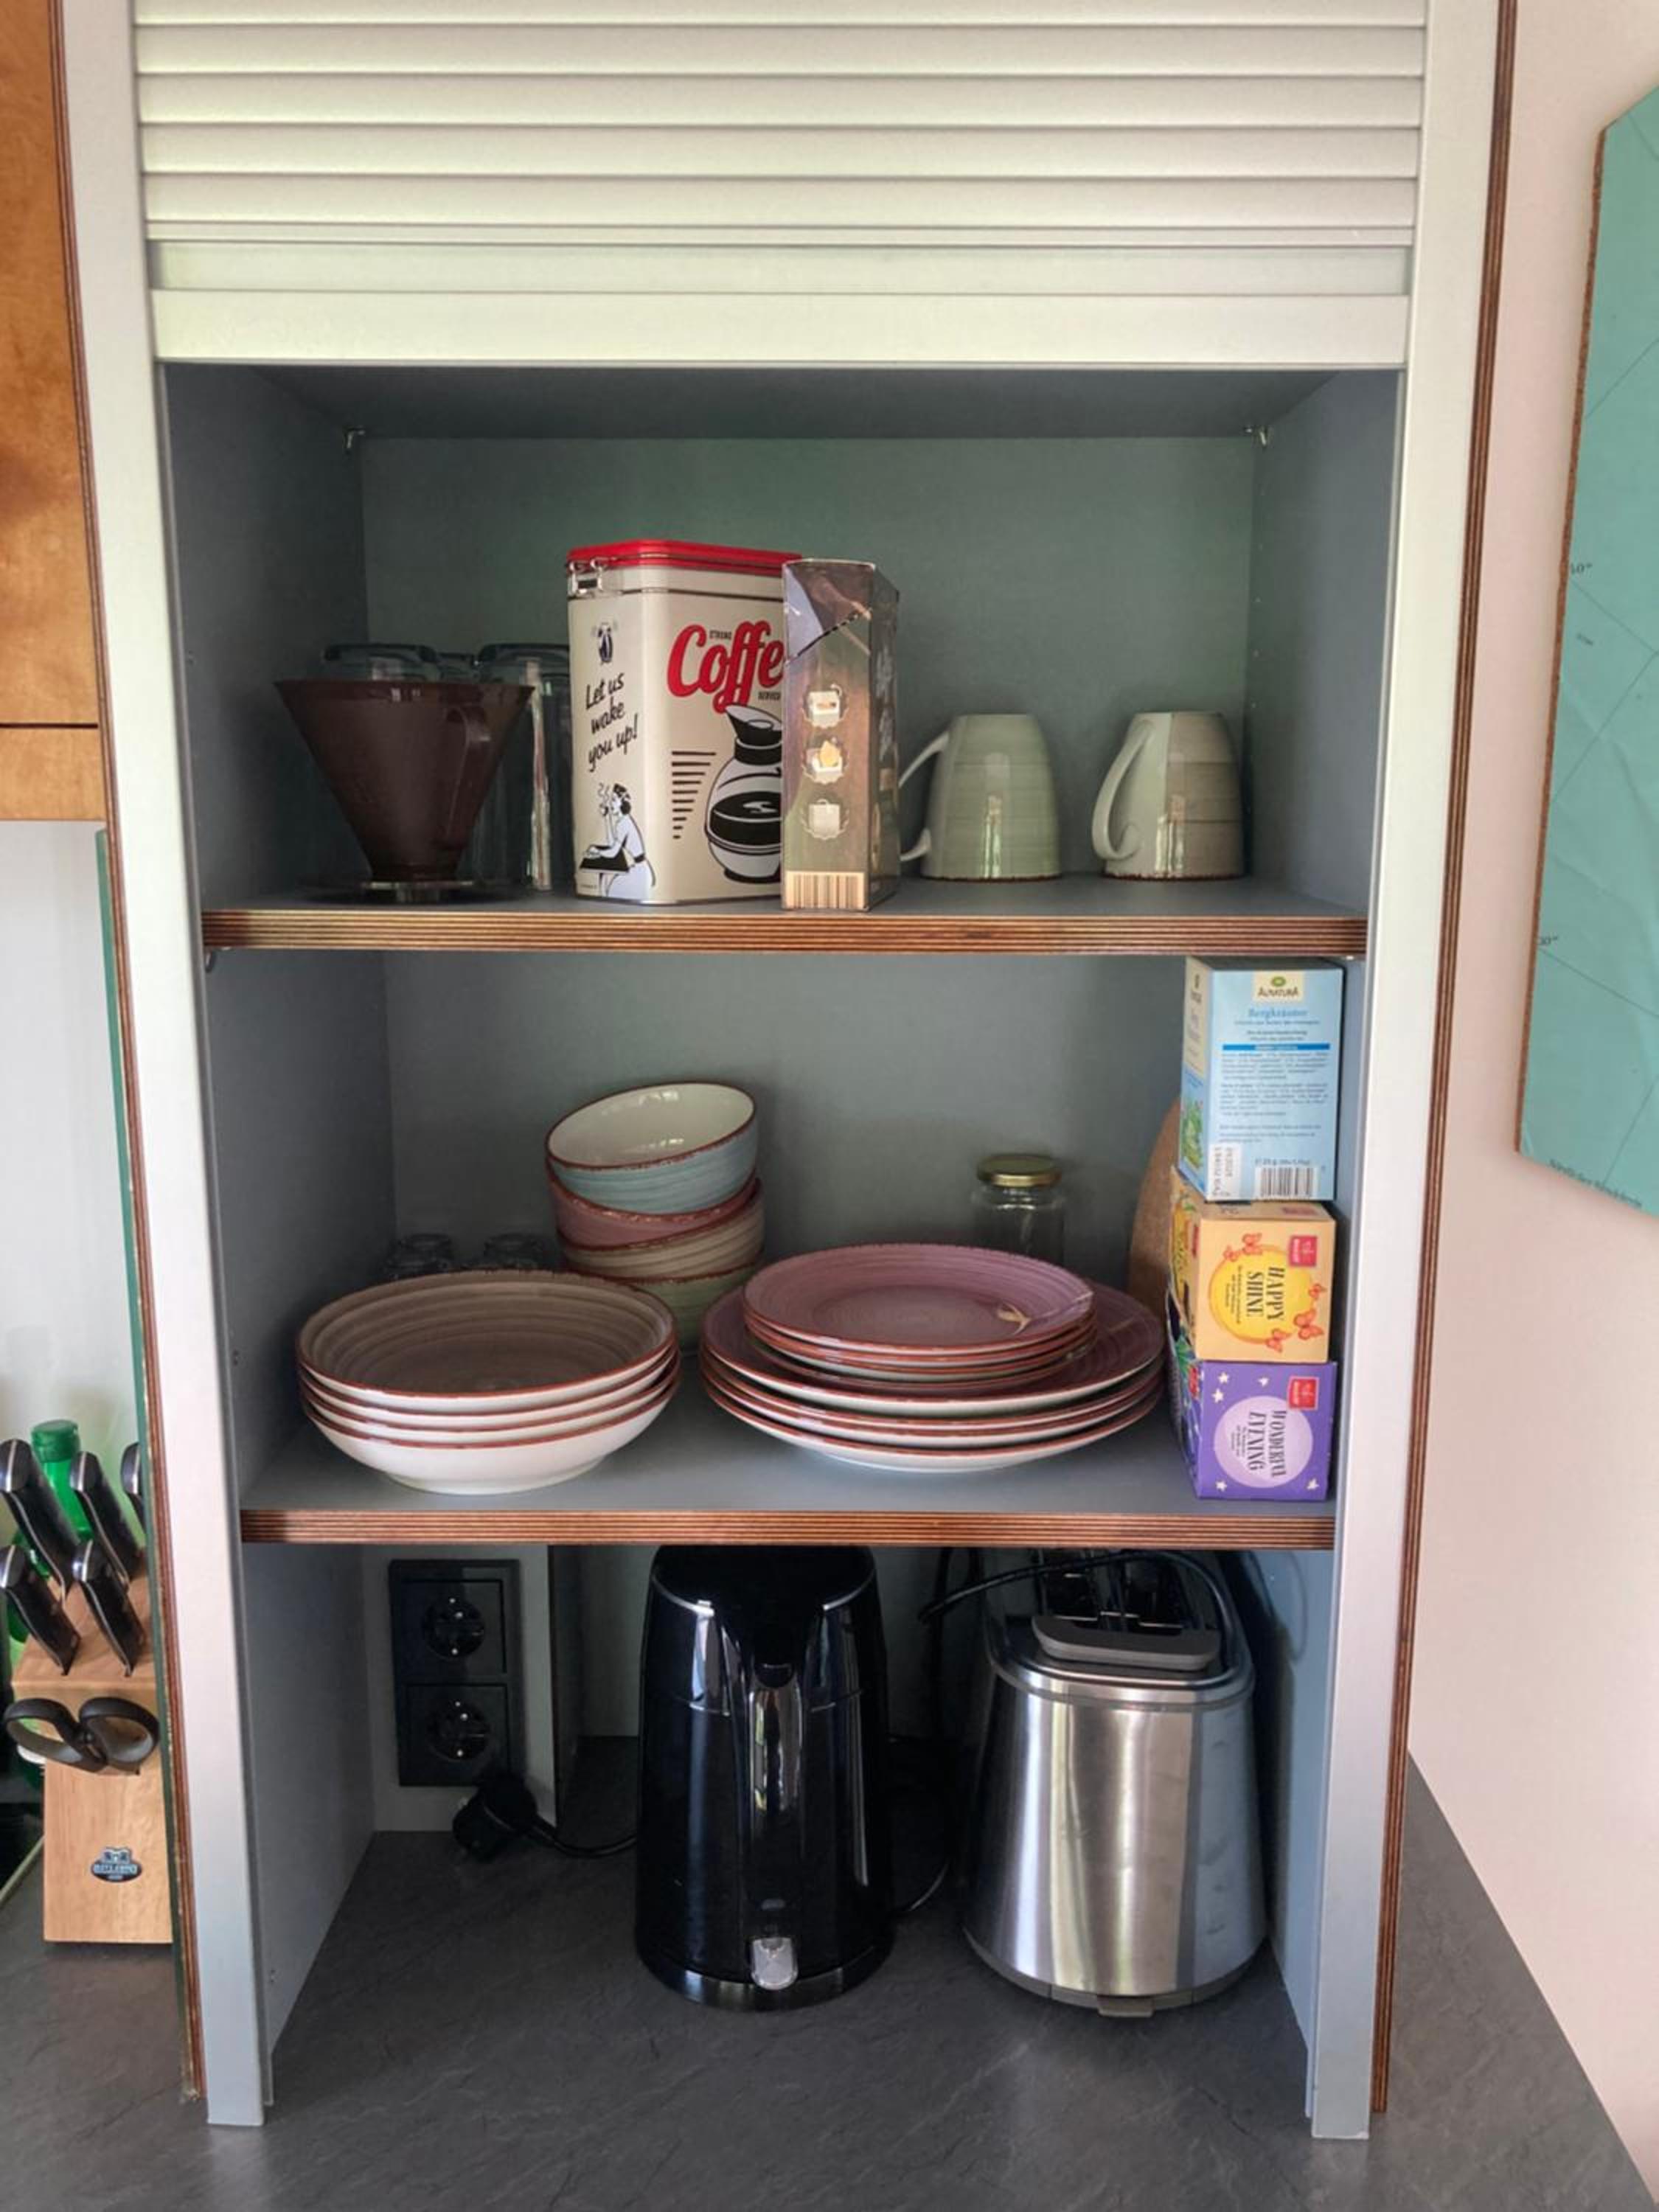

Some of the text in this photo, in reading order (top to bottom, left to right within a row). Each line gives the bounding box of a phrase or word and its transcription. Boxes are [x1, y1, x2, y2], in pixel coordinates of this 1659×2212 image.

[585, 672, 625, 710] Let us
[667, 620, 785, 714] Coffe
[588, 712, 638, 773] you up!
[591, 695, 625, 734] wake
[1246, 1270, 1264, 1317] SHINE
[1266, 1267, 1285, 1321] HAPPY
[1247, 1411, 1267, 1471] EVENING
[1268, 1410, 1287, 1478] WONDERFUL
